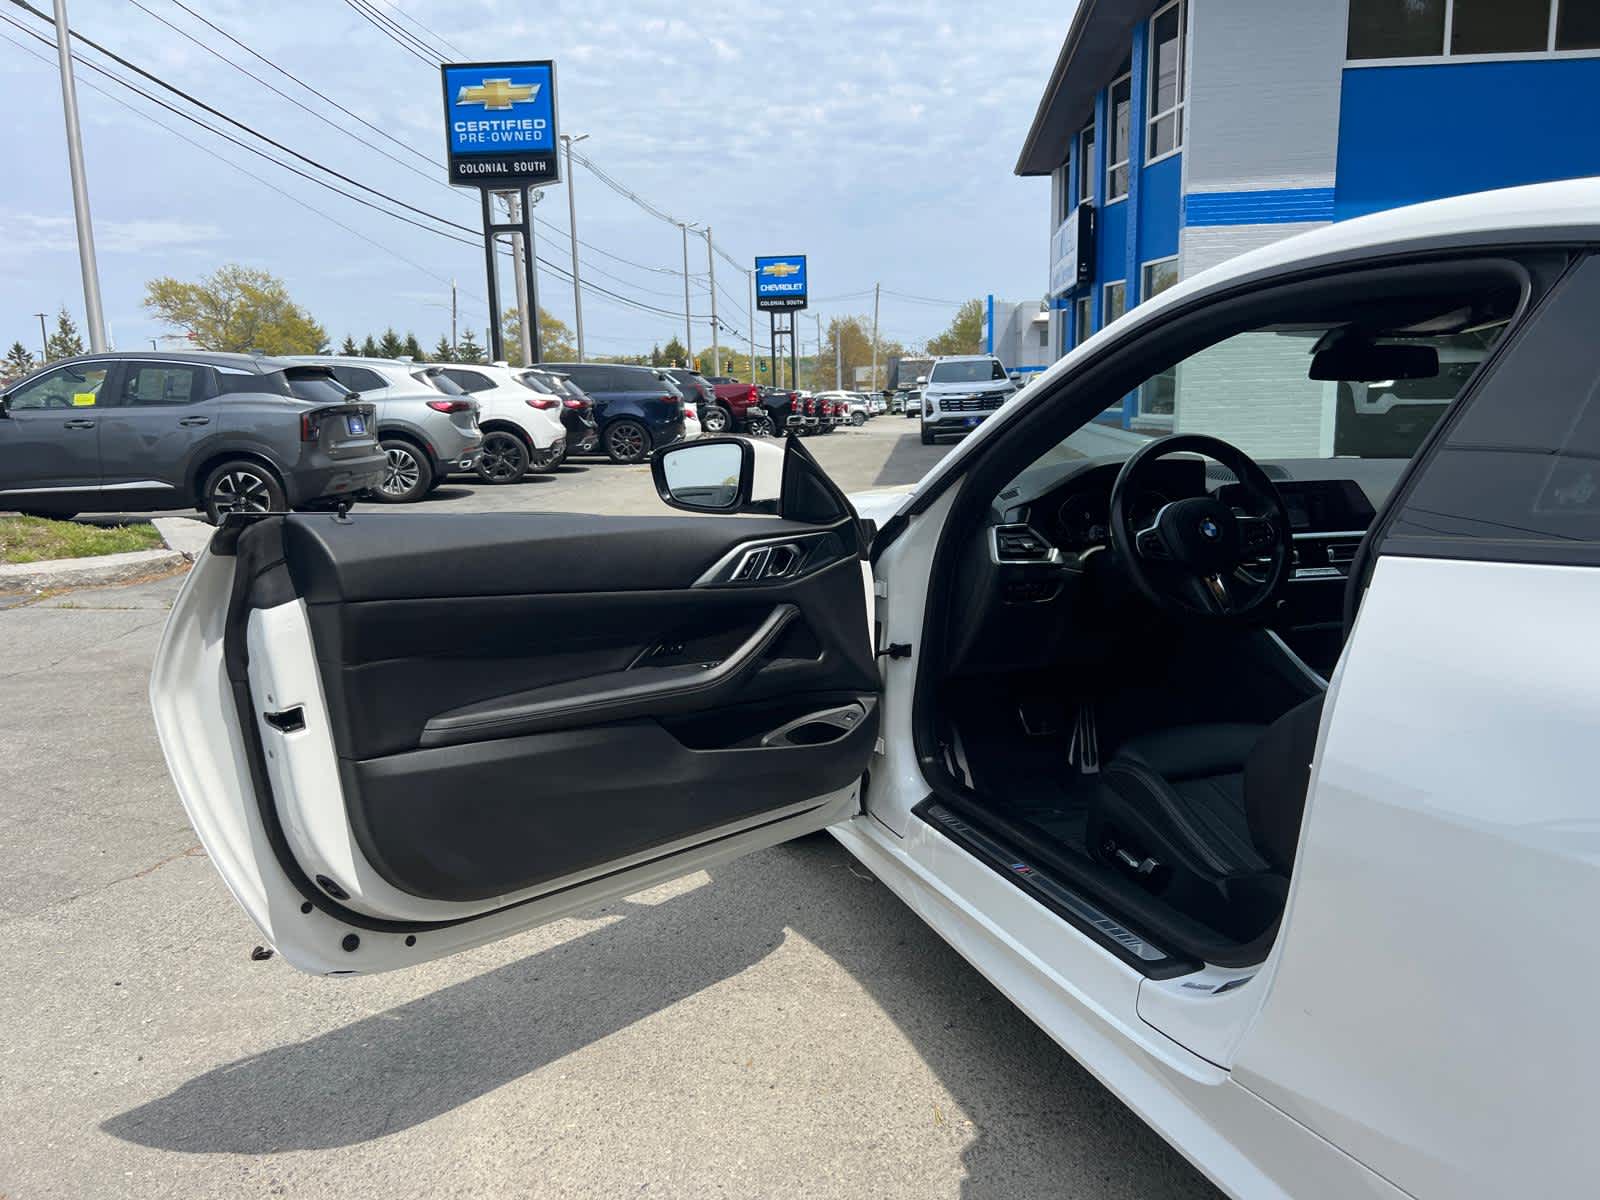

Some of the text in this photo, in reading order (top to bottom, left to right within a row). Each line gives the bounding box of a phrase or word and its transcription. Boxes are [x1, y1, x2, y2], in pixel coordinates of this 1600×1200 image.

[454, 119, 546, 132] CERTIFIED
[459, 131, 542, 143] PRE-OWNED
[460, 161, 547, 174] COLONIAL SOUTH
[760, 283, 803, 292] CHEVROLET
